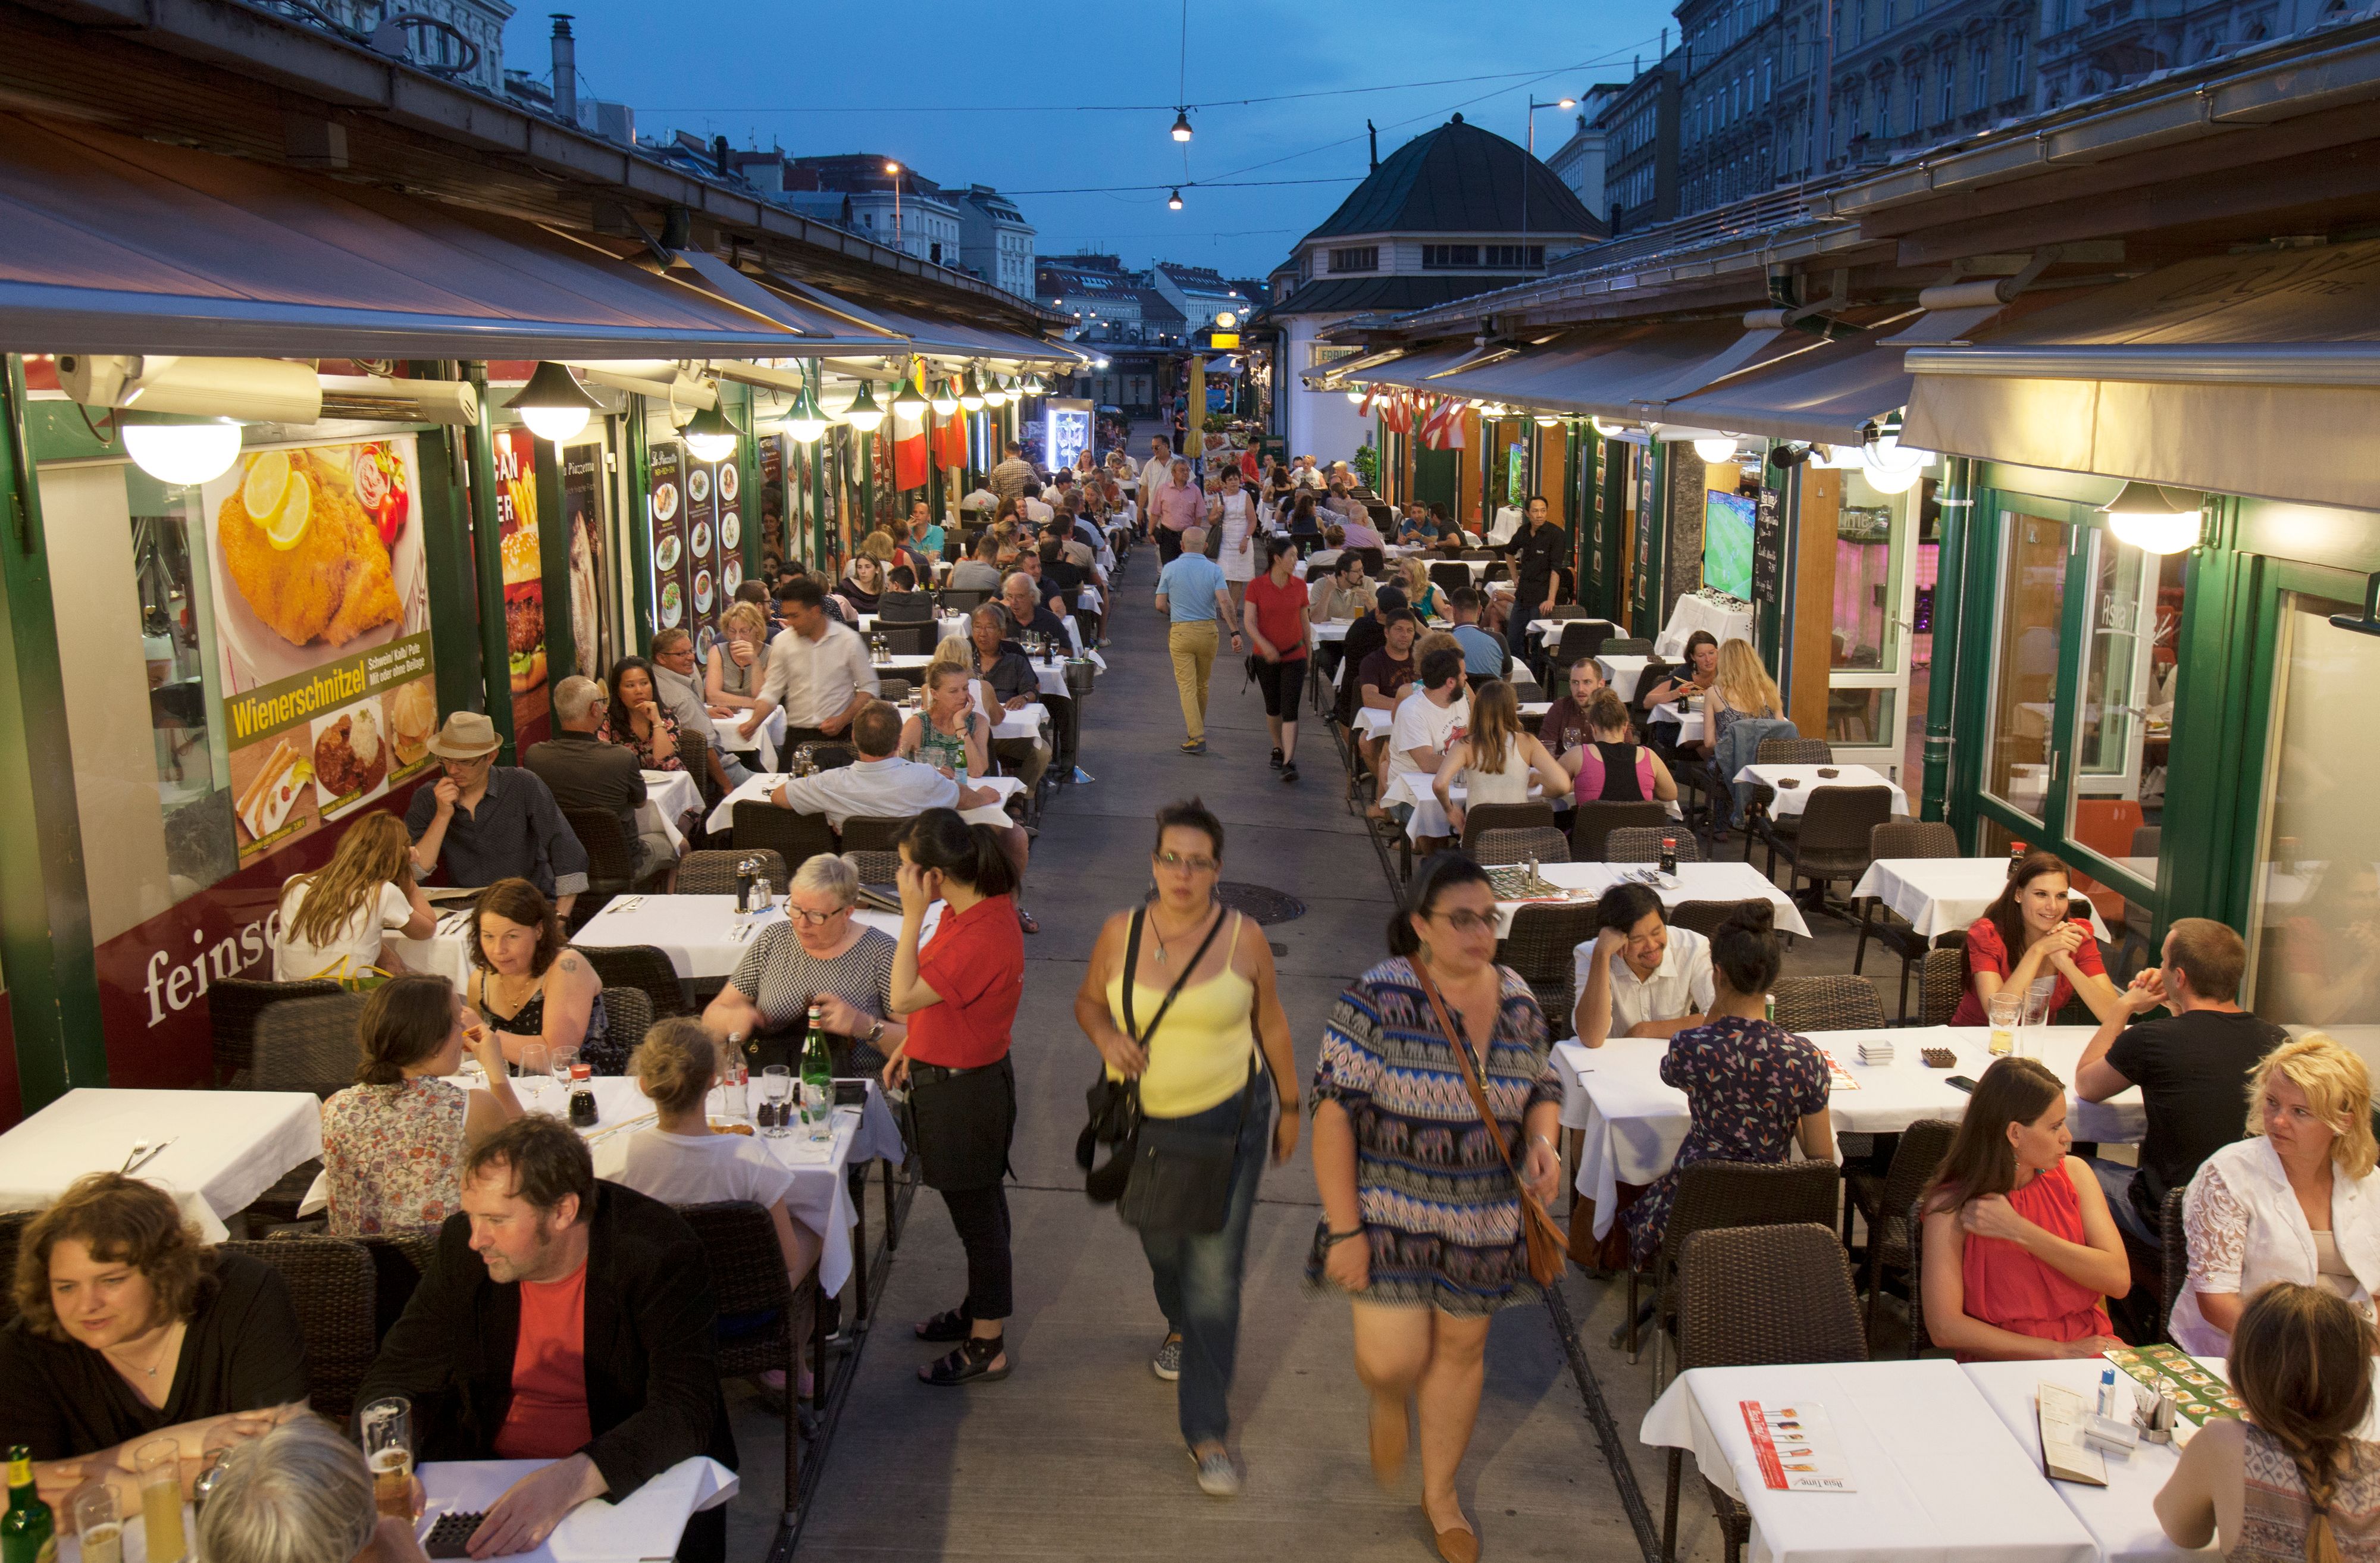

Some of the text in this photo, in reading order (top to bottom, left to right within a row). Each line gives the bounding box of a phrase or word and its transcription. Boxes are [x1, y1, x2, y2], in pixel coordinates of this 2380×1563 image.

[2102, 595, 2126, 629] Asia
[408, 643, 420, 656] Pute
[369, 657, 425, 686] Mit oder ohne Beilage
[232, 659, 366, 738] Wienerschnitzel
[143, 909, 279, 1028] feinsc
[1802, 1479, 1843, 1488] Asia Time
